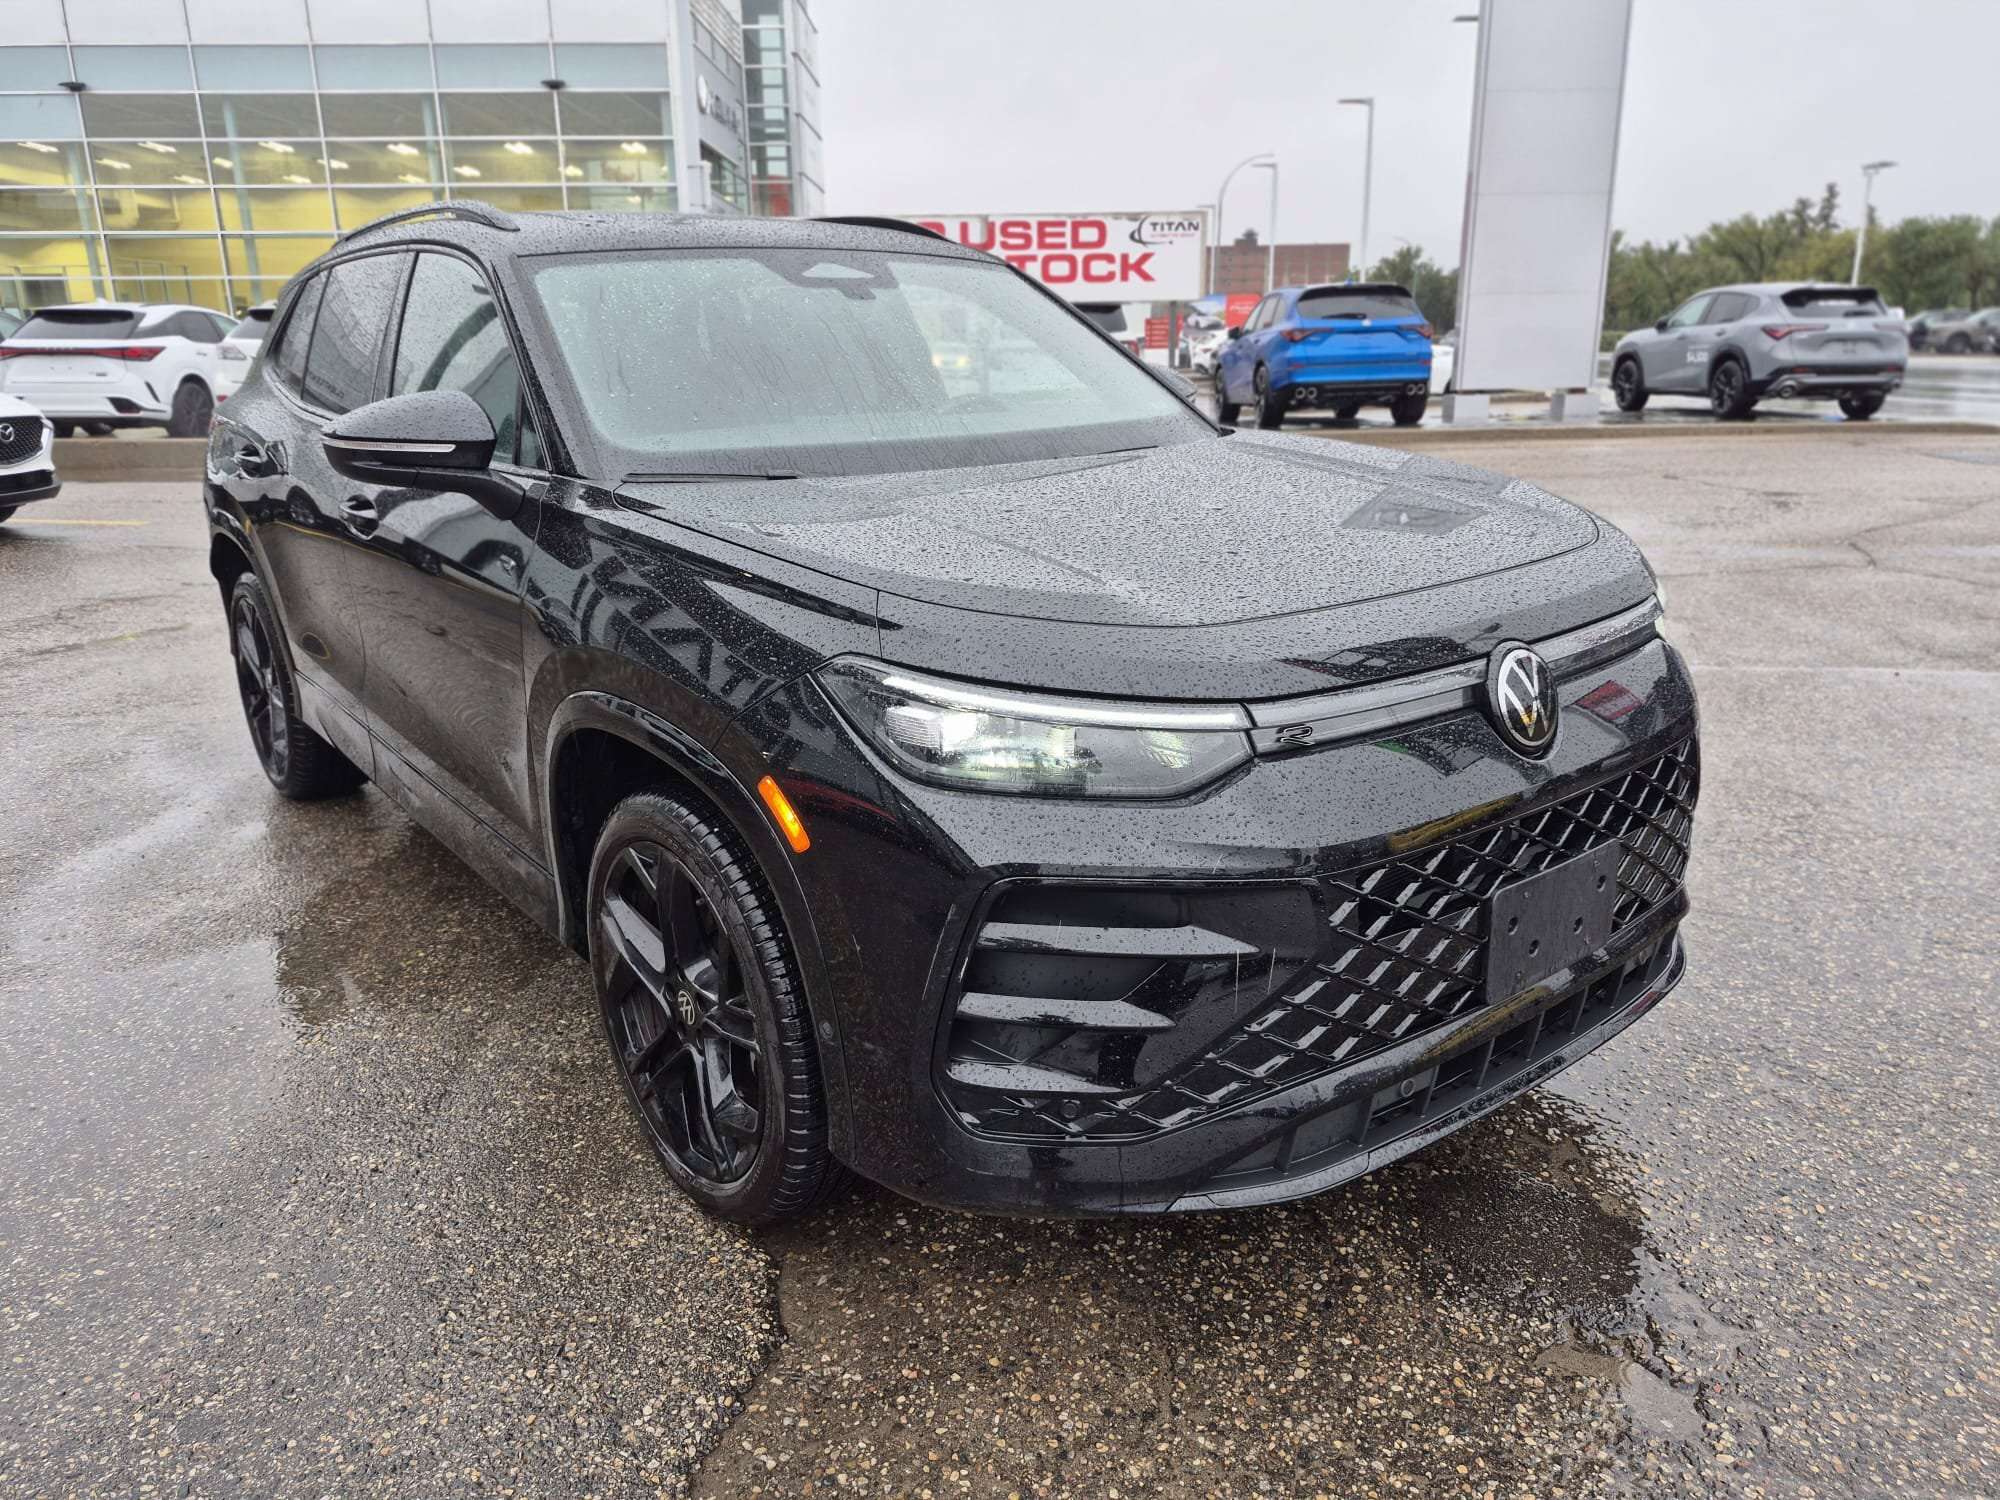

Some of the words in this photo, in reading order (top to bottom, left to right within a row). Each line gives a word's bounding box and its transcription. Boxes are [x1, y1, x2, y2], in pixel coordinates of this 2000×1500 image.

[960, 219, 1107, 251] USED
[1150, 222, 1200, 232] TITAN
[1004, 252, 1156, 283] TOCK
